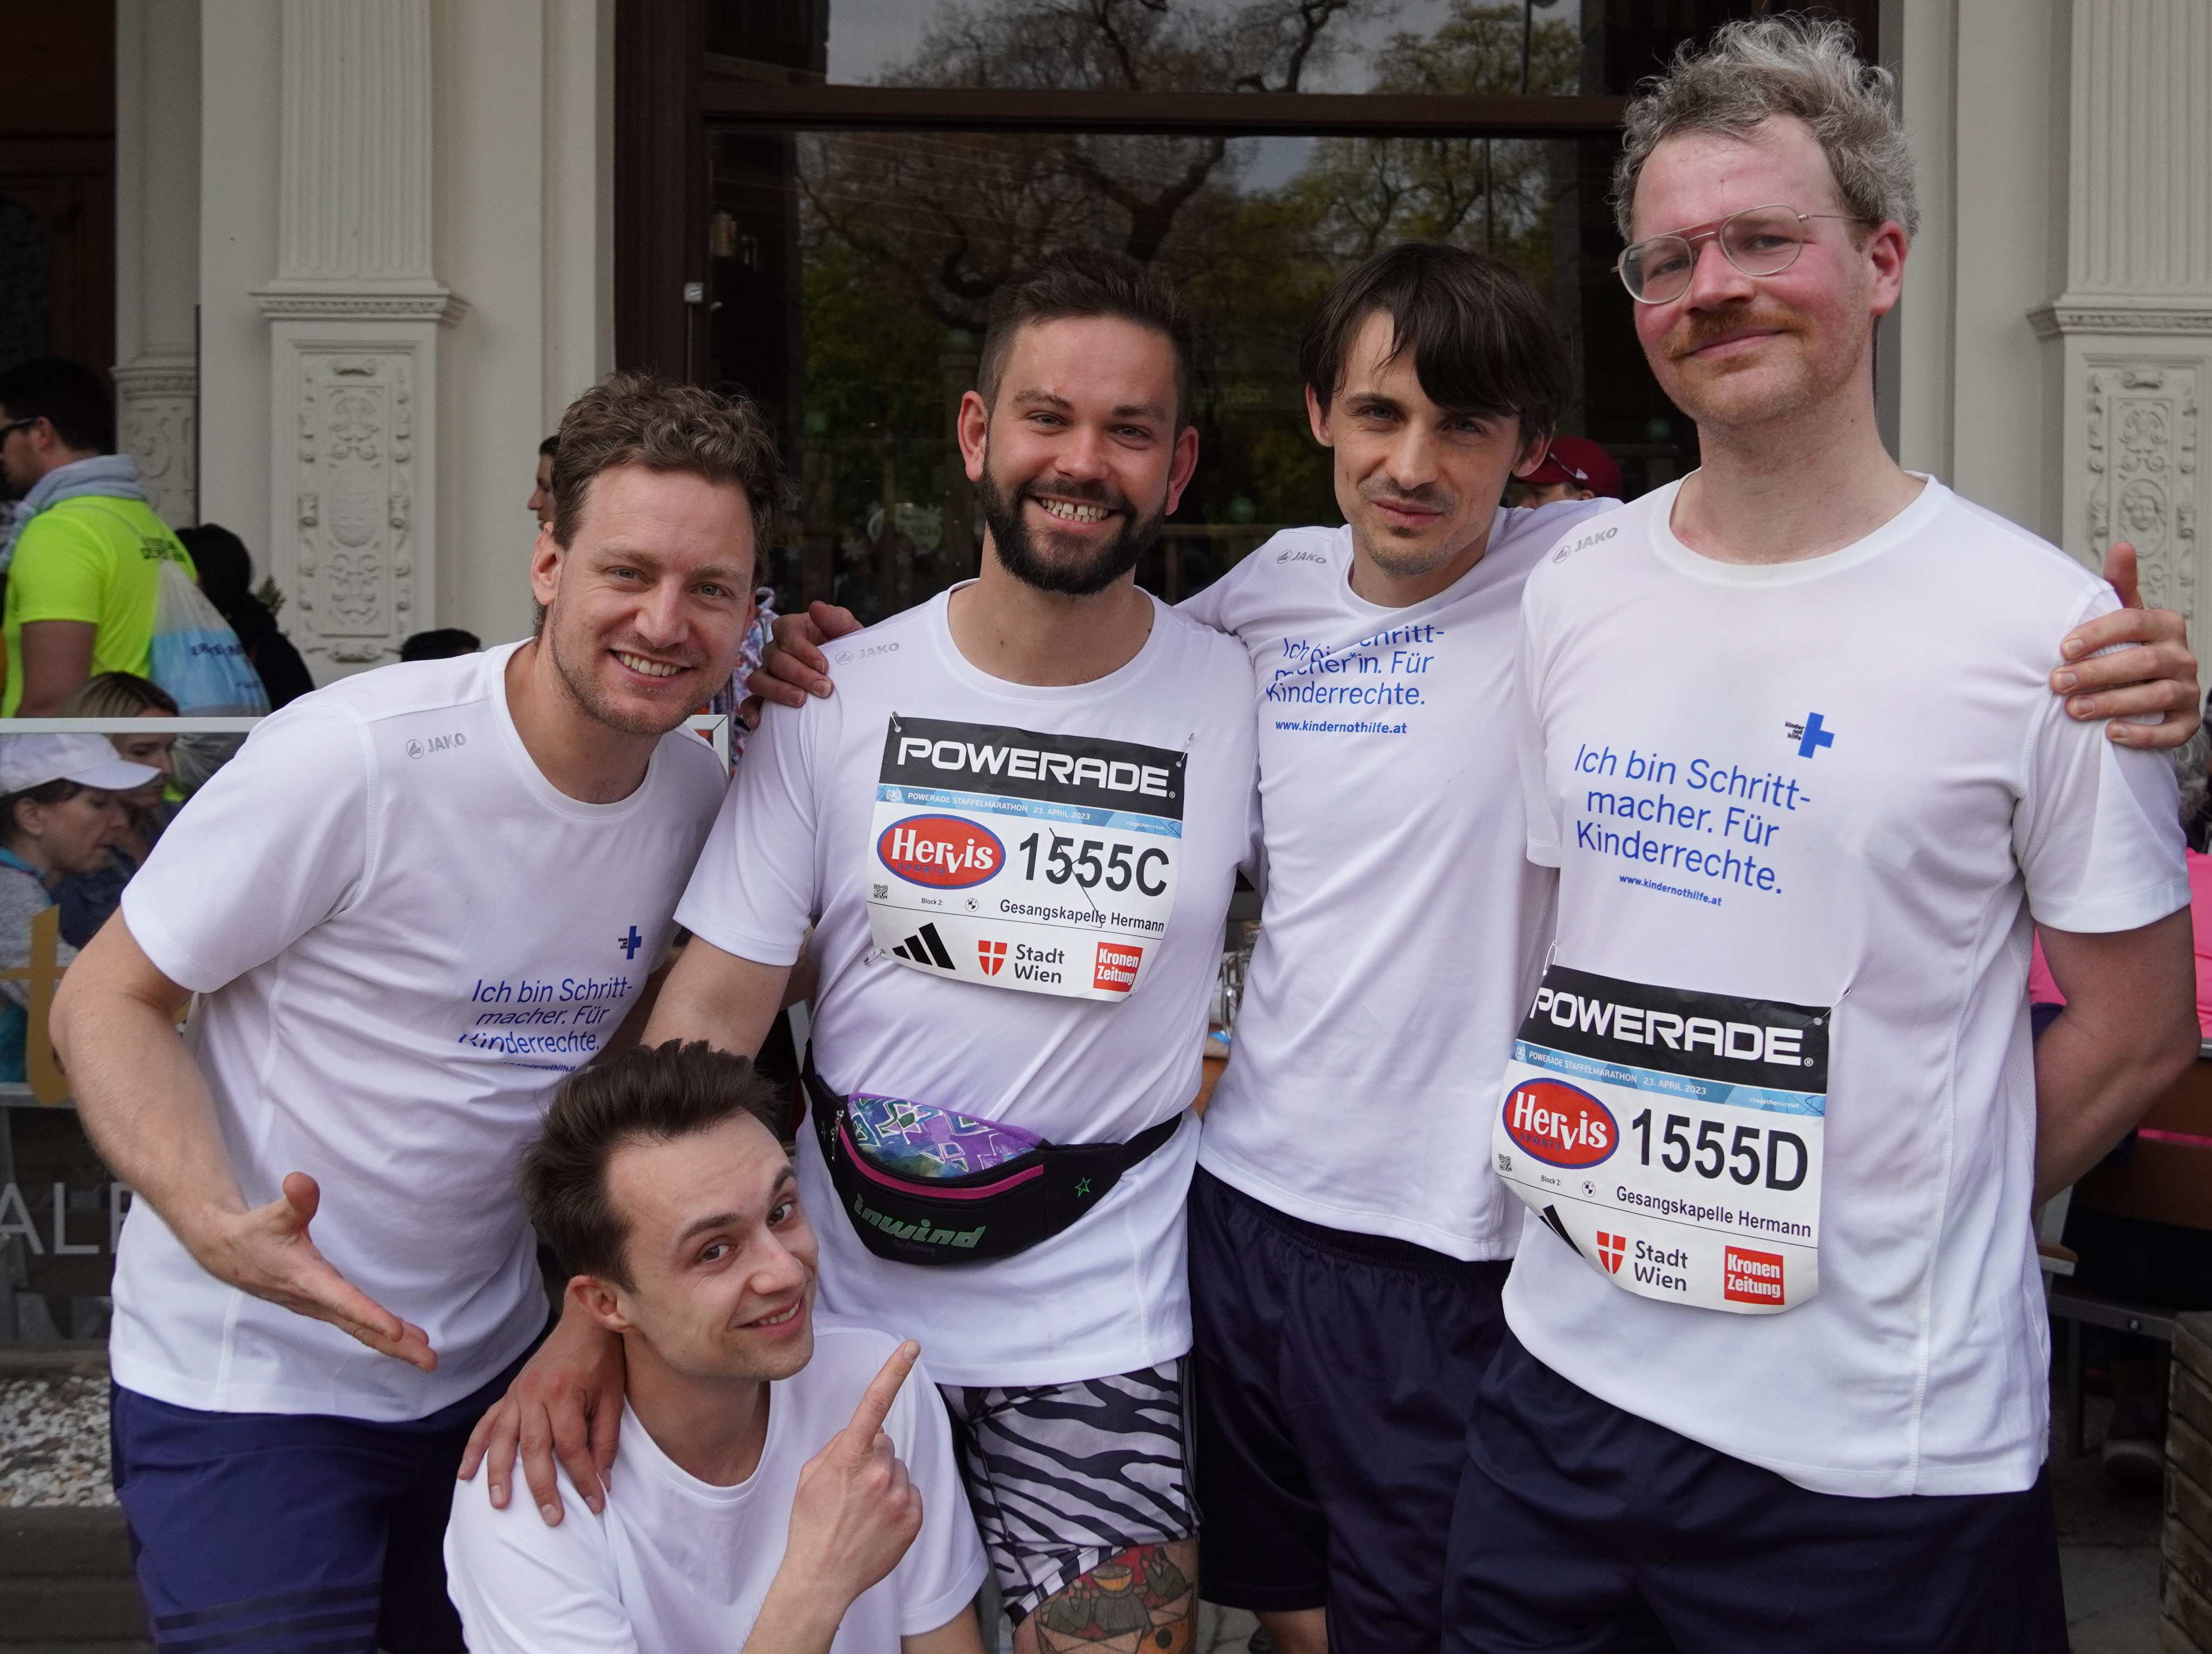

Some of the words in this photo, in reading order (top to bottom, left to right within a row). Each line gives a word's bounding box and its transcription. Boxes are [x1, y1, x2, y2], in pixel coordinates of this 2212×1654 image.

[1574, 527, 1618, 553] JAKO
[1291, 551, 1327, 564] JAKO
[858, 642, 900, 660] JAKO
[1282, 637, 1310, 661] Ich
[1391, 651, 1434, 674] Für
[1266, 680, 1425, 705] Kinderrechte.
[1275, 720, 1407, 734] www.kindernothilfe.at
[428, 732, 466, 753] JAKO
[1574, 744, 1617, 776] Ich
[1625, 750, 1677, 785] bin
[1686, 758, 1811, 811] Schritt-
[907, 792, 951, 804] POWERADE
[952, 797, 1028, 812] STAFFELMARATHON
[1033, 806, 1045, 815] 23.
[1047, 809, 1069, 818] APRIL
[1070, 811, 1090, 820] 2023
[1587, 790, 1712, 833] macher.
[1724, 806, 1779, 847] Für
[891, 827, 994, 874] Hervis
[1576, 819, 1782, 894] Kinderrechte.
[897, 863, 946, 875] SPORTS
[1019, 831, 1169, 897] 1555C
[1618, 874, 1723, 906] www.kindernothilfe.at
[1000, 898, 1107, 924] Gesangskapelle
[1110, 912, 1164, 933] Hermann
[1015, 943, 1065, 964] Stadt
[1098, 948, 1140, 968] Kronen
[1014, 962, 1062, 984] Wien
[1096, 965, 1135, 985] Zeitung
[472, 979, 512, 1002] Ich
[517, 980, 553, 1002] bin
[559, 976, 632, 1001] Schritt-
[476, 1008, 568, 1026] macher.
[572, 1005, 610, 1025] Für
[1529, 1051, 1563, 1066] POWERADE
[1565, 1060, 1637, 1082] STAFFELMARATHON
[1643, 1077, 1656, 1086] 23.
[1658, 1080, 1681, 1090] APRIL
[1684, 1085, 1706, 1095] 2023
[1513, 1091, 1607, 1151] Hervis
[1519, 1133, 1562, 1151] SPORTS
[1632, 1108, 1808, 1191] 1555D
[1541, 1175, 1555, 1184] Block
[1617, 1185, 1733, 1224] Gesangskapelle
[1738, 1210, 1811, 1237] Hermann
[1635, 1240, 1688, 1269] Stadt
[1727, 1253, 1781, 1278] Kronen
[1634, 1262, 1687, 1291] Wien
[1727, 1274, 1781, 1298] Zeitung
